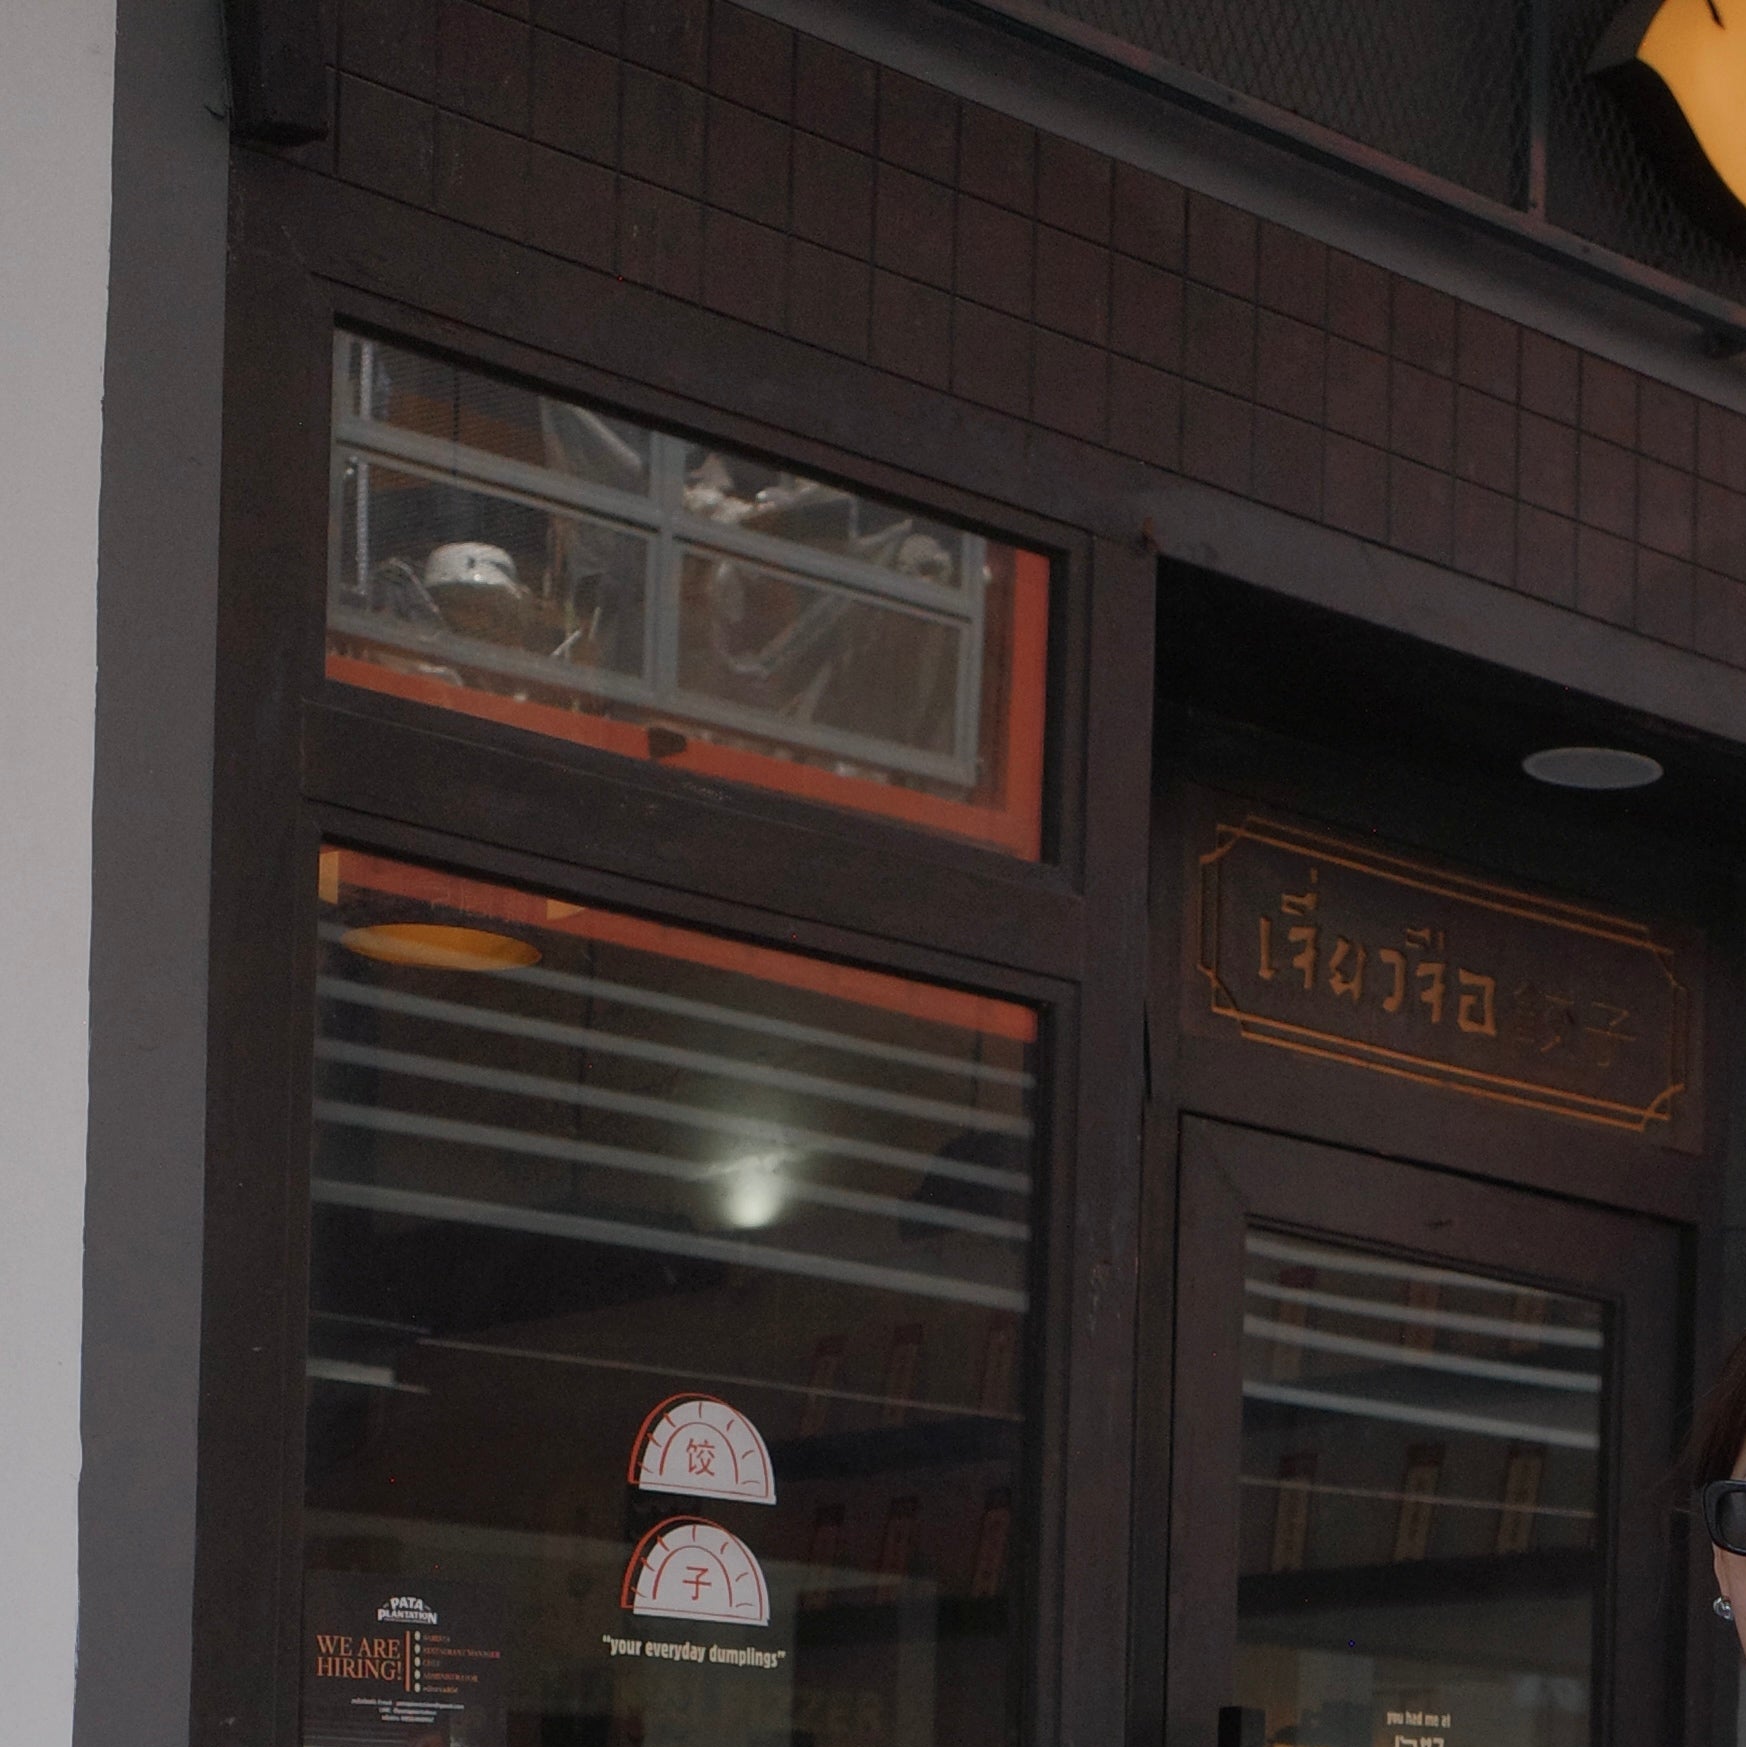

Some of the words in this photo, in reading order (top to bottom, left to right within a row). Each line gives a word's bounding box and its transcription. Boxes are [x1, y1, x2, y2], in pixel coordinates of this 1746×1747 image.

[390, 1596, 423, 1611] PATA
[377, 1609, 438, 1624] PLANTATION
[316, 1635, 353, 1657] WE
[358, 1637, 401, 1660] ARE
[645, 1641, 706, 1663] everyday
[316, 1656, 402, 1681] HIRING!
